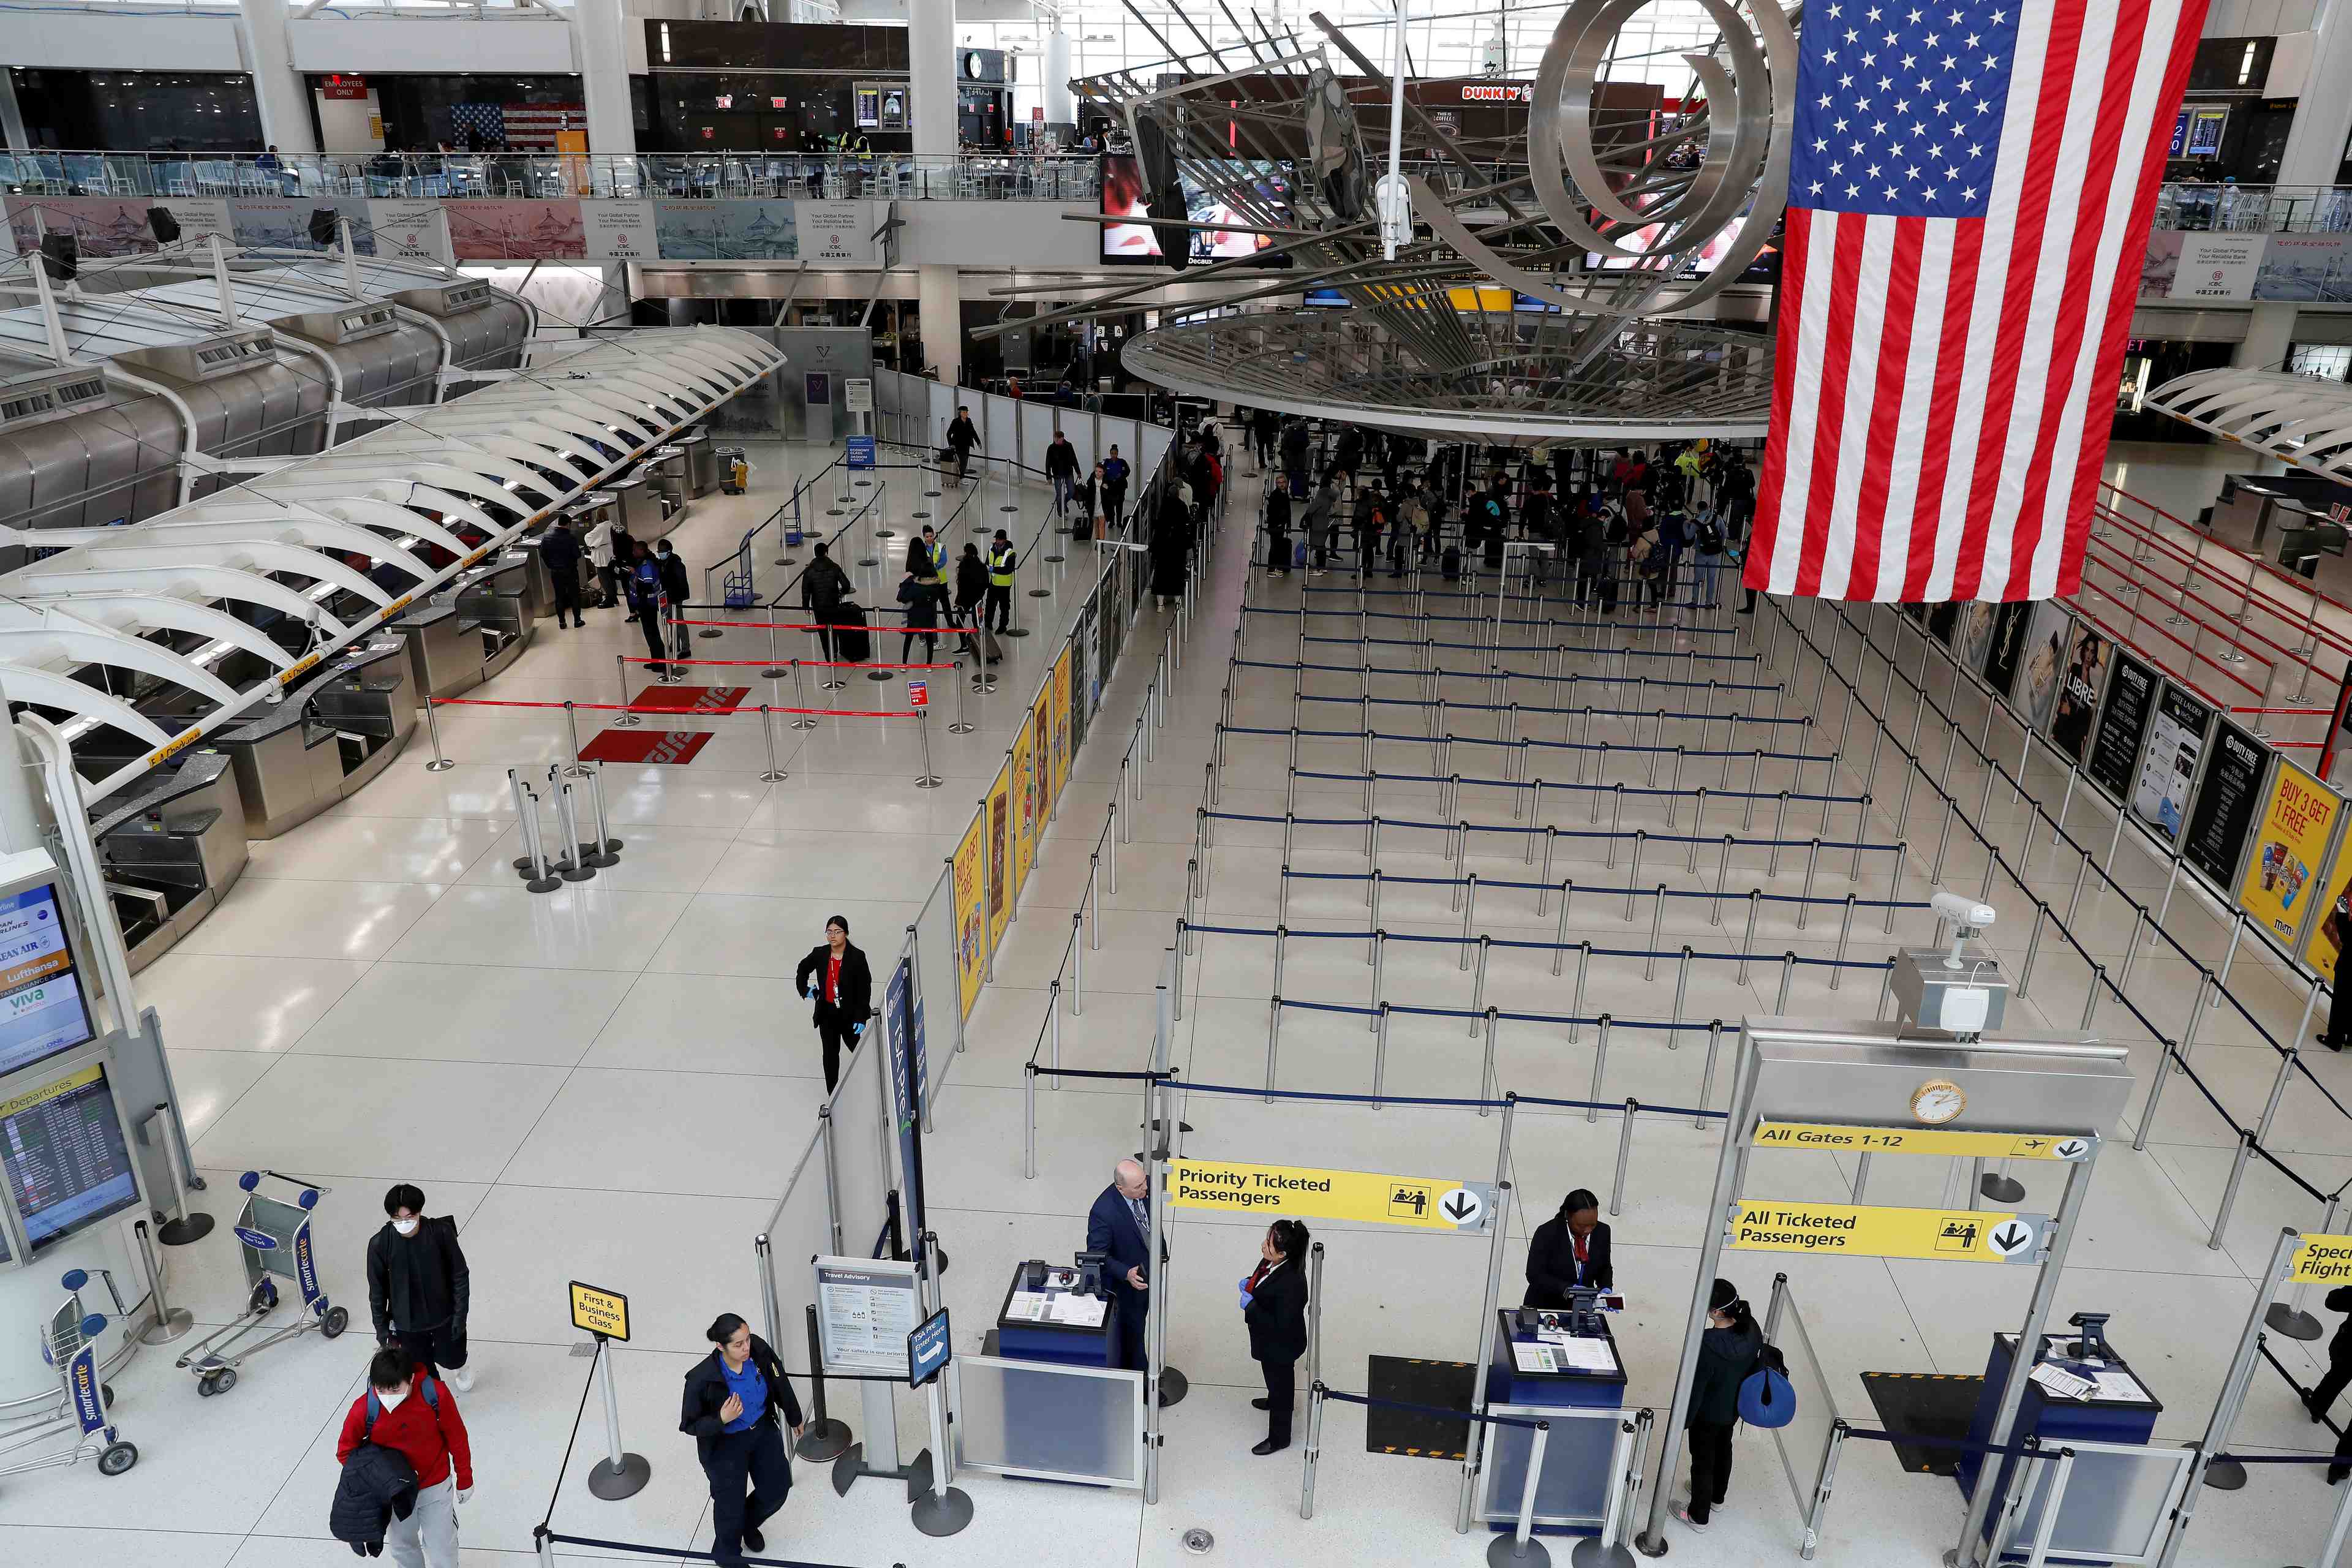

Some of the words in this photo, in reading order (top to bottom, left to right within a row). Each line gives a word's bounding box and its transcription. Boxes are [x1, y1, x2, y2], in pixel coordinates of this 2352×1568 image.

[774, 99, 785, 108] EXIT
[1463, 87, 1520, 100] DUNKIN'
[2067, 672, 2095, 707] LIBRE
[2127, 668, 2139, 685] DUTY
[2137, 675, 2149, 690] FREE
[2183, 699, 2203, 718] LAUDER
[2233, 740, 2246, 756] DUTY
[2244, 747, 2258, 765] FREE
[2280, 778, 2302, 805] BUY
[2301, 793, 2310, 812] 3
[2309, 799, 2331, 826] GET
[2275, 799, 2282, 818] 1
[2282, 804, 2309, 837] FREE
[956, 859, 965, 889] BUY
[970, 831, 979, 860] GET
[962, 867, 973, 899] FREE
[21, 941, 39, 955] AIR
[7, 959, 59, 983] Lufthansa
[15, 976, 50, 993] ALLIANCE
[10, 988, 45, 1009] viva
[895, 1014, 903, 1072] TSA
[10, 1079, 72, 1109] Departures
[1762, 1129, 1791, 1142] All
[1796, 1131, 1853, 1145] Gates
[1861, 1134, 1902, 1147] 1-12
[1180, 1168, 1247, 1188] Priority
[1253, 1174, 1330, 1193] Ticketed
[1180, 1186, 1281, 1205] Passengers
[1743, 1211, 1770, 1226] All
[1776, 1213, 1857, 1231] Ticketed
[1740, 1228, 1846, 1248] Passengers
[299, 1238, 315, 1292] smartecarte
[579, 1302, 620, 1321] Business
[584, 1293, 605, 1306] First
[607, 1300, 614, 1309] &
[588, 1316, 612, 1329] Class
[913, 1330, 925, 1343] TSA
[926, 1322, 937, 1333] Pre
[915, 1338, 931, 1352] Enter
[932, 1325, 946, 1338] Here
[78, 1364, 97, 1421] smartecarte
